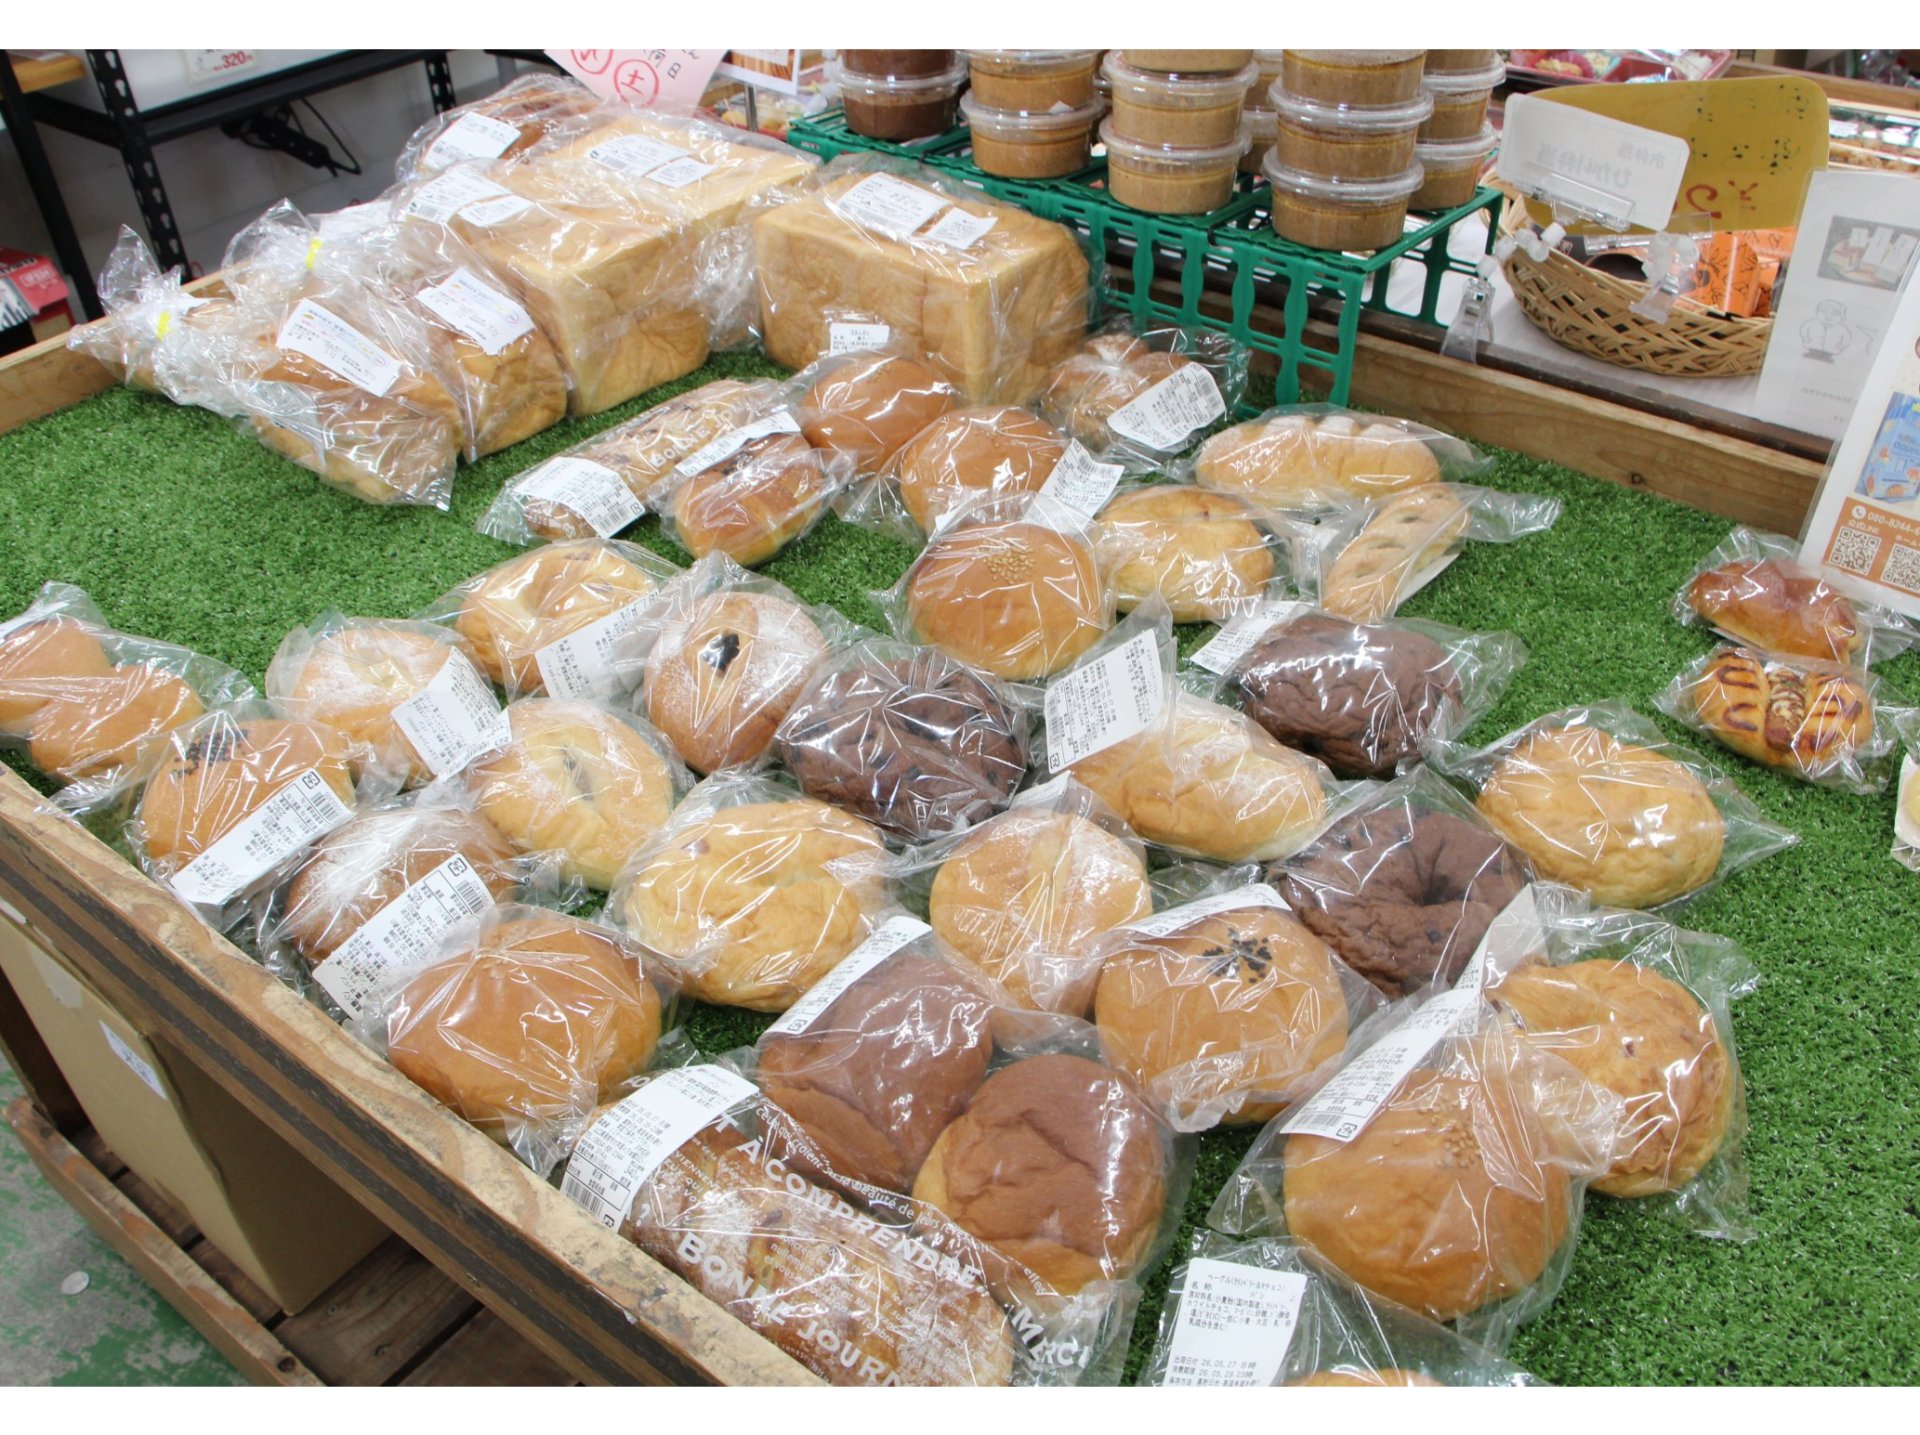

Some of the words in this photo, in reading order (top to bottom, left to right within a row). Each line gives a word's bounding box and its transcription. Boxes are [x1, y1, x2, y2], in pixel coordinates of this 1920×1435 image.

[685, 1175, 704, 1195] QUI
[736, 1134, 764, 1165] À
[764, 1157, 983, 1290] COMPRENDRE
[897, 1201, 916, 1220] de
[677, 1231, 792, 1326] BONNE
[1011, 1307, 1090, 1370] MERCI
[1172, 1365, 1196, 1376] 消費期限
[1174, 1356, 1199, 1367] 出荷日付
